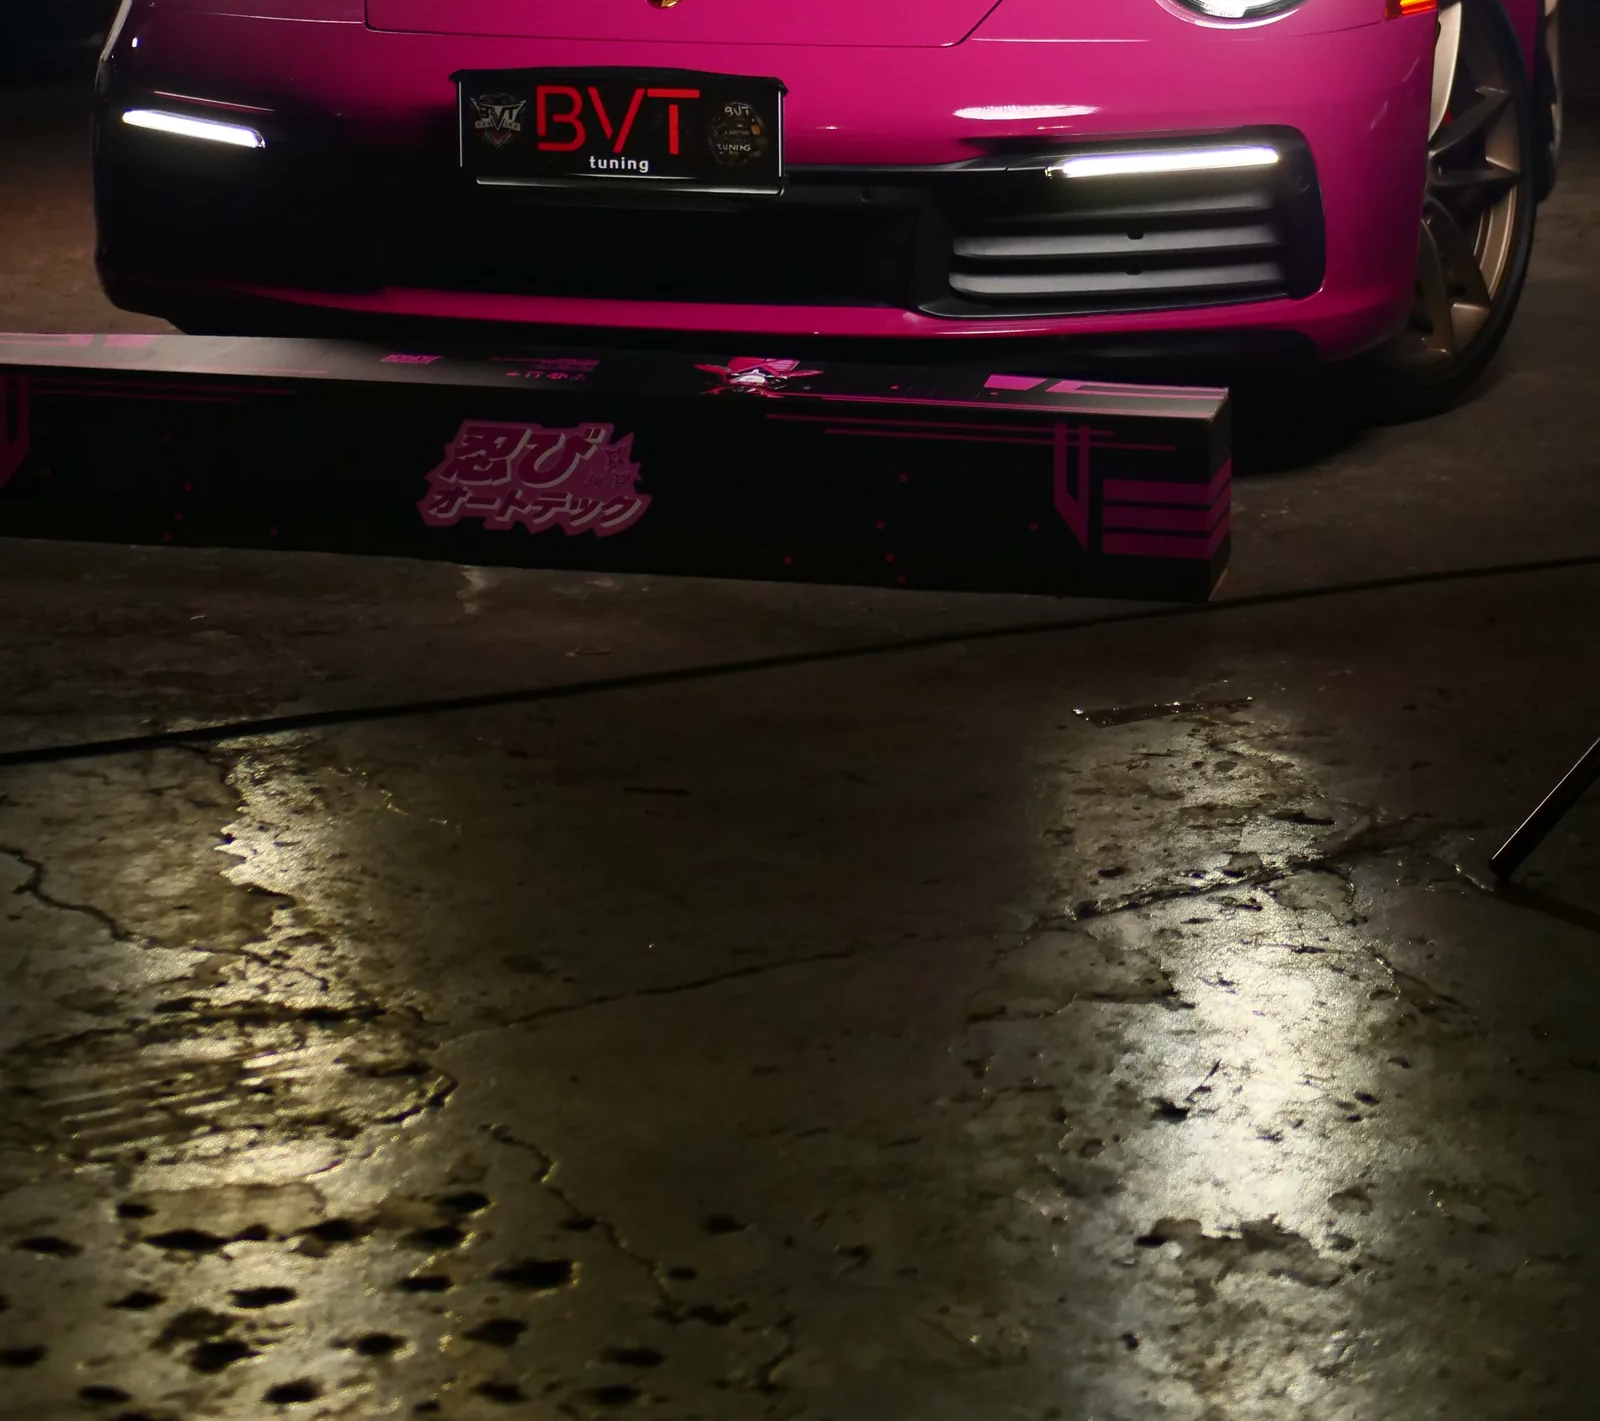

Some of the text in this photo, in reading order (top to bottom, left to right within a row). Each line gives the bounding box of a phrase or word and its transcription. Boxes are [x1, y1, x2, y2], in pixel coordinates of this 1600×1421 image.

[536, 85, 700, 155] BVT
[724, 106, 751, 117] BVT
[589, 155, 649, 174] tuning
[437, 425, 607, 489] 忍び
[428, 486, 643, 529] オートテック
